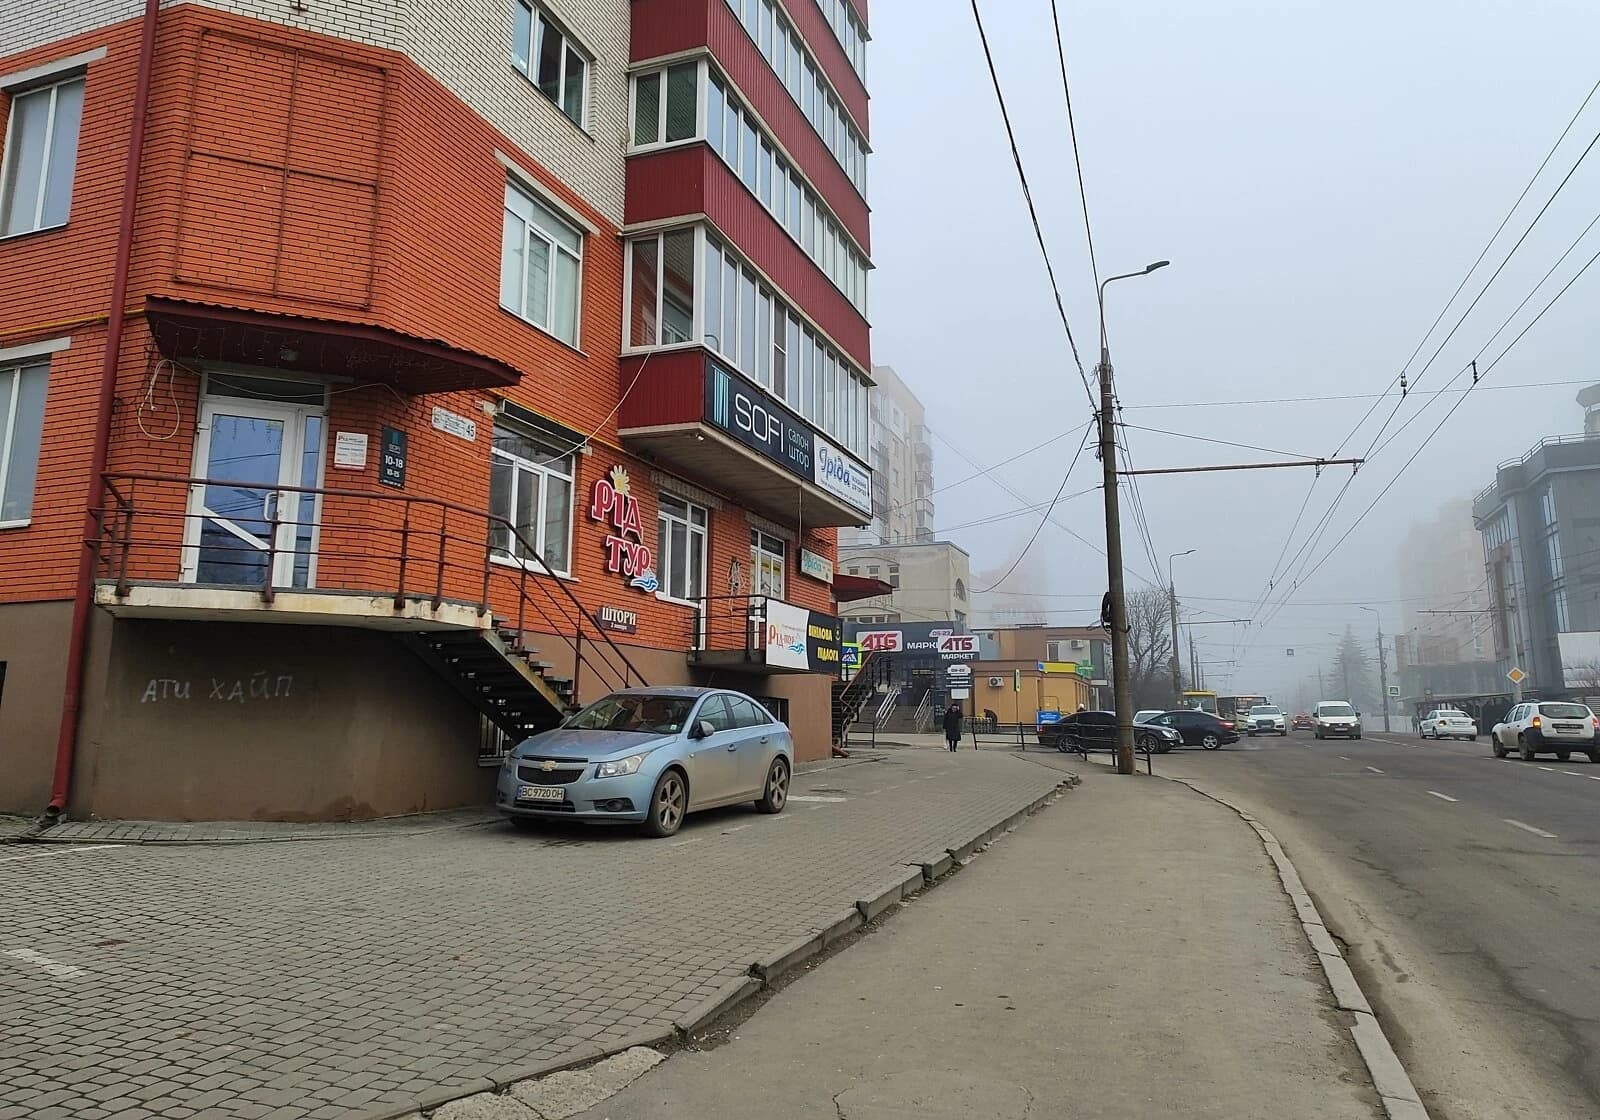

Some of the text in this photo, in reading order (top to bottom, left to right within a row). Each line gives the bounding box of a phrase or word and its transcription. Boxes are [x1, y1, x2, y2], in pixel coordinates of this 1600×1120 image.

[735, 393, 784, 453] SOFI
[788, 428, 809, 452] салон
[385, 455, 404, 469] 10-18
[788, 444, 810, 472] штор
[861, 633, 938, 650] АТБ МАРК
[941, 637, 973, 650] АТБ
[209, 671, 293, 704] ХАЙП
[534, 788, 550, 798] 9720
